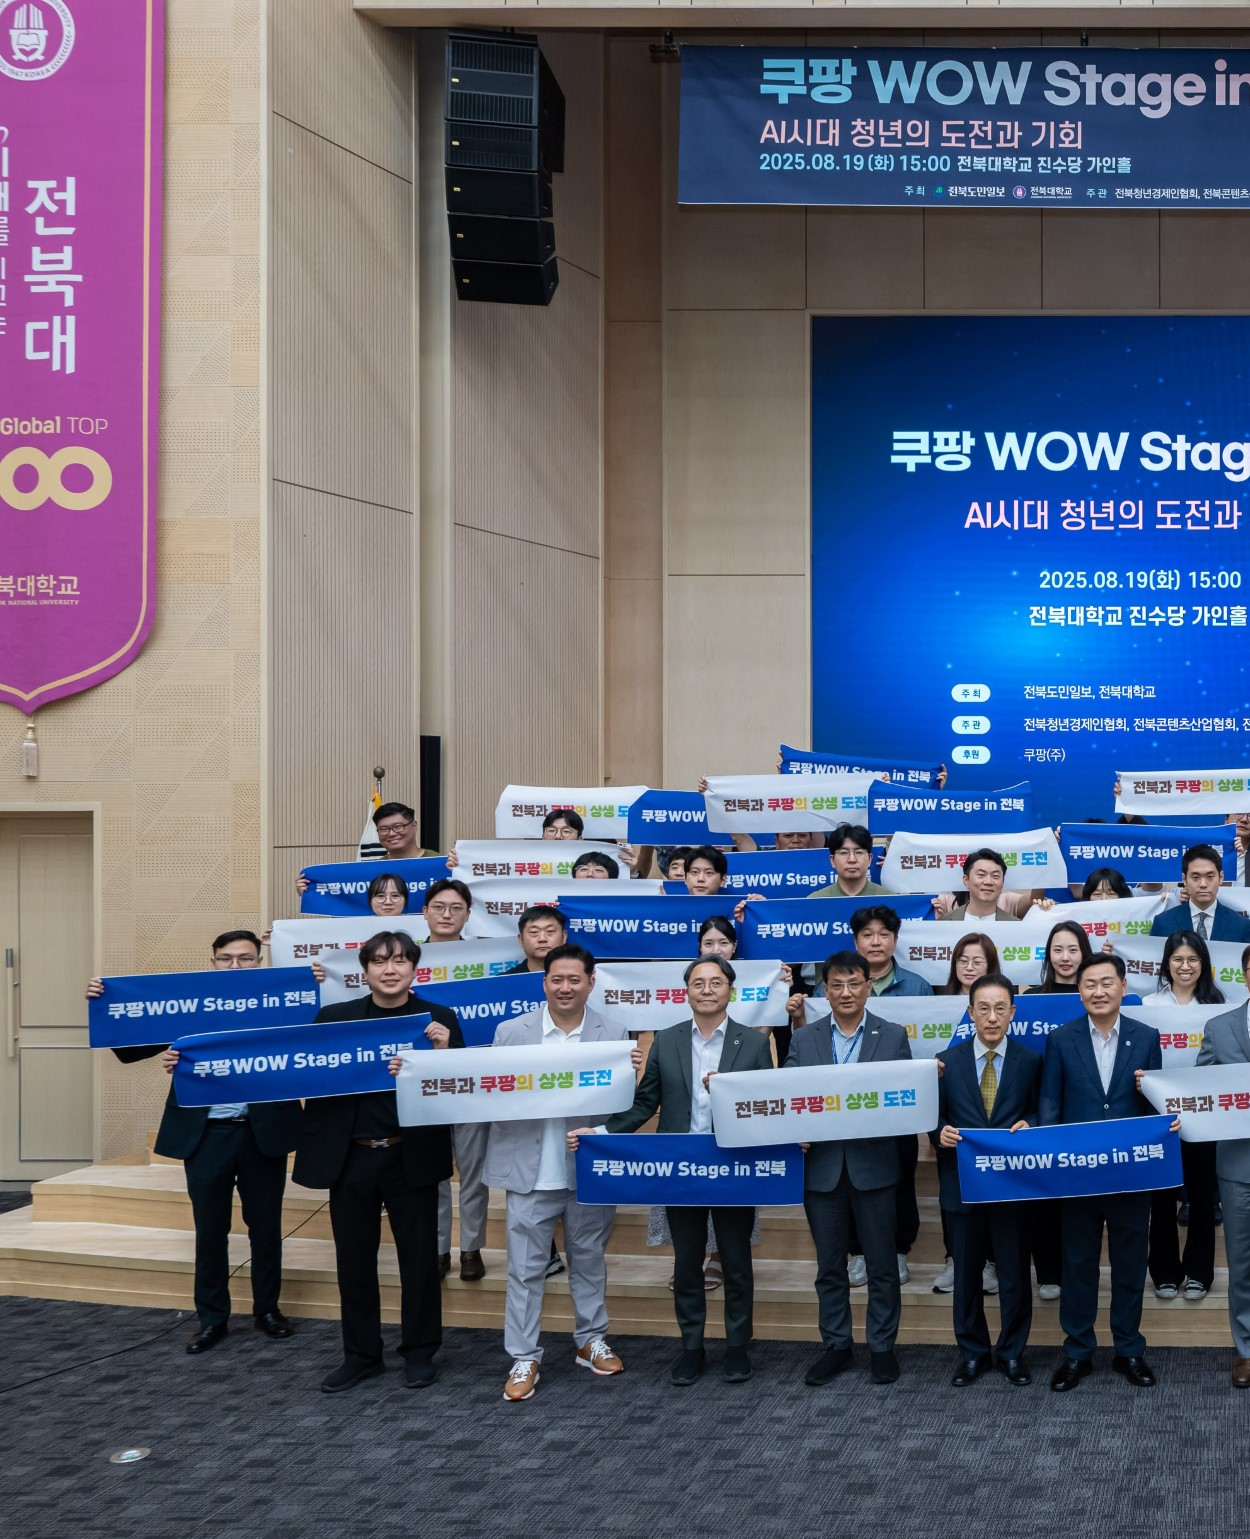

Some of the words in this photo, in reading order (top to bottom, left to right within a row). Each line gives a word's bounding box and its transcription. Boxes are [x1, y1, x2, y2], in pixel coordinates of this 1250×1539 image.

[760, 59, 857, 104] 쿠팡
[867, 60, 1032, 105] WOW
[1044, 61, 1206, 119] Stage
[760, 119, 839, 146] AI시대
[851, 119, 929, 147] 청년의
[941, 121, 1022, 149] 도전과
[1032, 121, 1081, 149] 기회
[900, 155, 950, 171] 15:00
[958, 156, 1032, 195] 전북대학교
[1038, 157, 1082, 173] 진수당
[1087, 157, 1131, 173] 가인홀
[948, 186, 1005, 197] 전북도민일보
[1031, 187, 1072, 195] 전북대학교
[24, 176, 83, 374] 전북대
[0, 416, 61, 435] Global
[66, 417, 108, 435] TOP
[891, 431, 975, 472] 쿠팡
[985, 432, 1129, 471] WOW
[965, 500, 1048, 530] AI시대
[1061, 500, 1143, 530] 청년의
[1156, 500, 1242, 530] 도전과
[1189, 571, 1241, 588] 15:00
[1030, 606, 1122, 626] 전북대학교
[1130, 606, 1186, 626] 진수당
[1192, 606, 1247, 626] 가인홀
[1024, 686, 1095, 699] 전북도민일보,
[1099, 685, 1156, 699] 전북대학교
[1024, 718, 1129, 731] 전북청년경제인협회,
[1133, 718, 1239, 731] 전북콘텐츠산업협회,
[963, 750, 979, 759] 후원
[1024, 748, 1065, 762] 쿠팡(주)
[724, 799, 764, 812] 전북과
[768, 798, 807, 811] 쿠팡의
[811, 797, 837, 810] 상생
[842, 796, 867, 808] 도전
[941, 799, 981, 812] Stage
[985, 799, 997, 810] in
[1001, 798, 1024, 811] 전북
[203, 996, 258, 1012] Stage
[263, 994, 279, 1007] in
[284, 990, 317, 1006] 전북
[421, 1077, 475, 1096] 전북과
[480, 1074, 532, 1093] 쿠팡의
[538, 1072, 573, 1089] 상생
[579, 1070, 611, 1086] 도전
[735, 1099, 786, 1118] 전북과
[791, 1095, 840, 1114] 쿠팡의
[846, 1092, 878, 1110] 상생
[884, 1089, 916, 1107] 도전
[1165, 1095, 1214, 1113] 전북과
[1058, 1153, 1108, 1168] Stage
[1113, 1148, 1128, 1163] in
[1133, 1144, 1164, 1162] 전북
[678, 1162, 729, 1179] Stage
[735, 1162, 750, 1176] in
[755, 1161, 786, 1176] 전북
